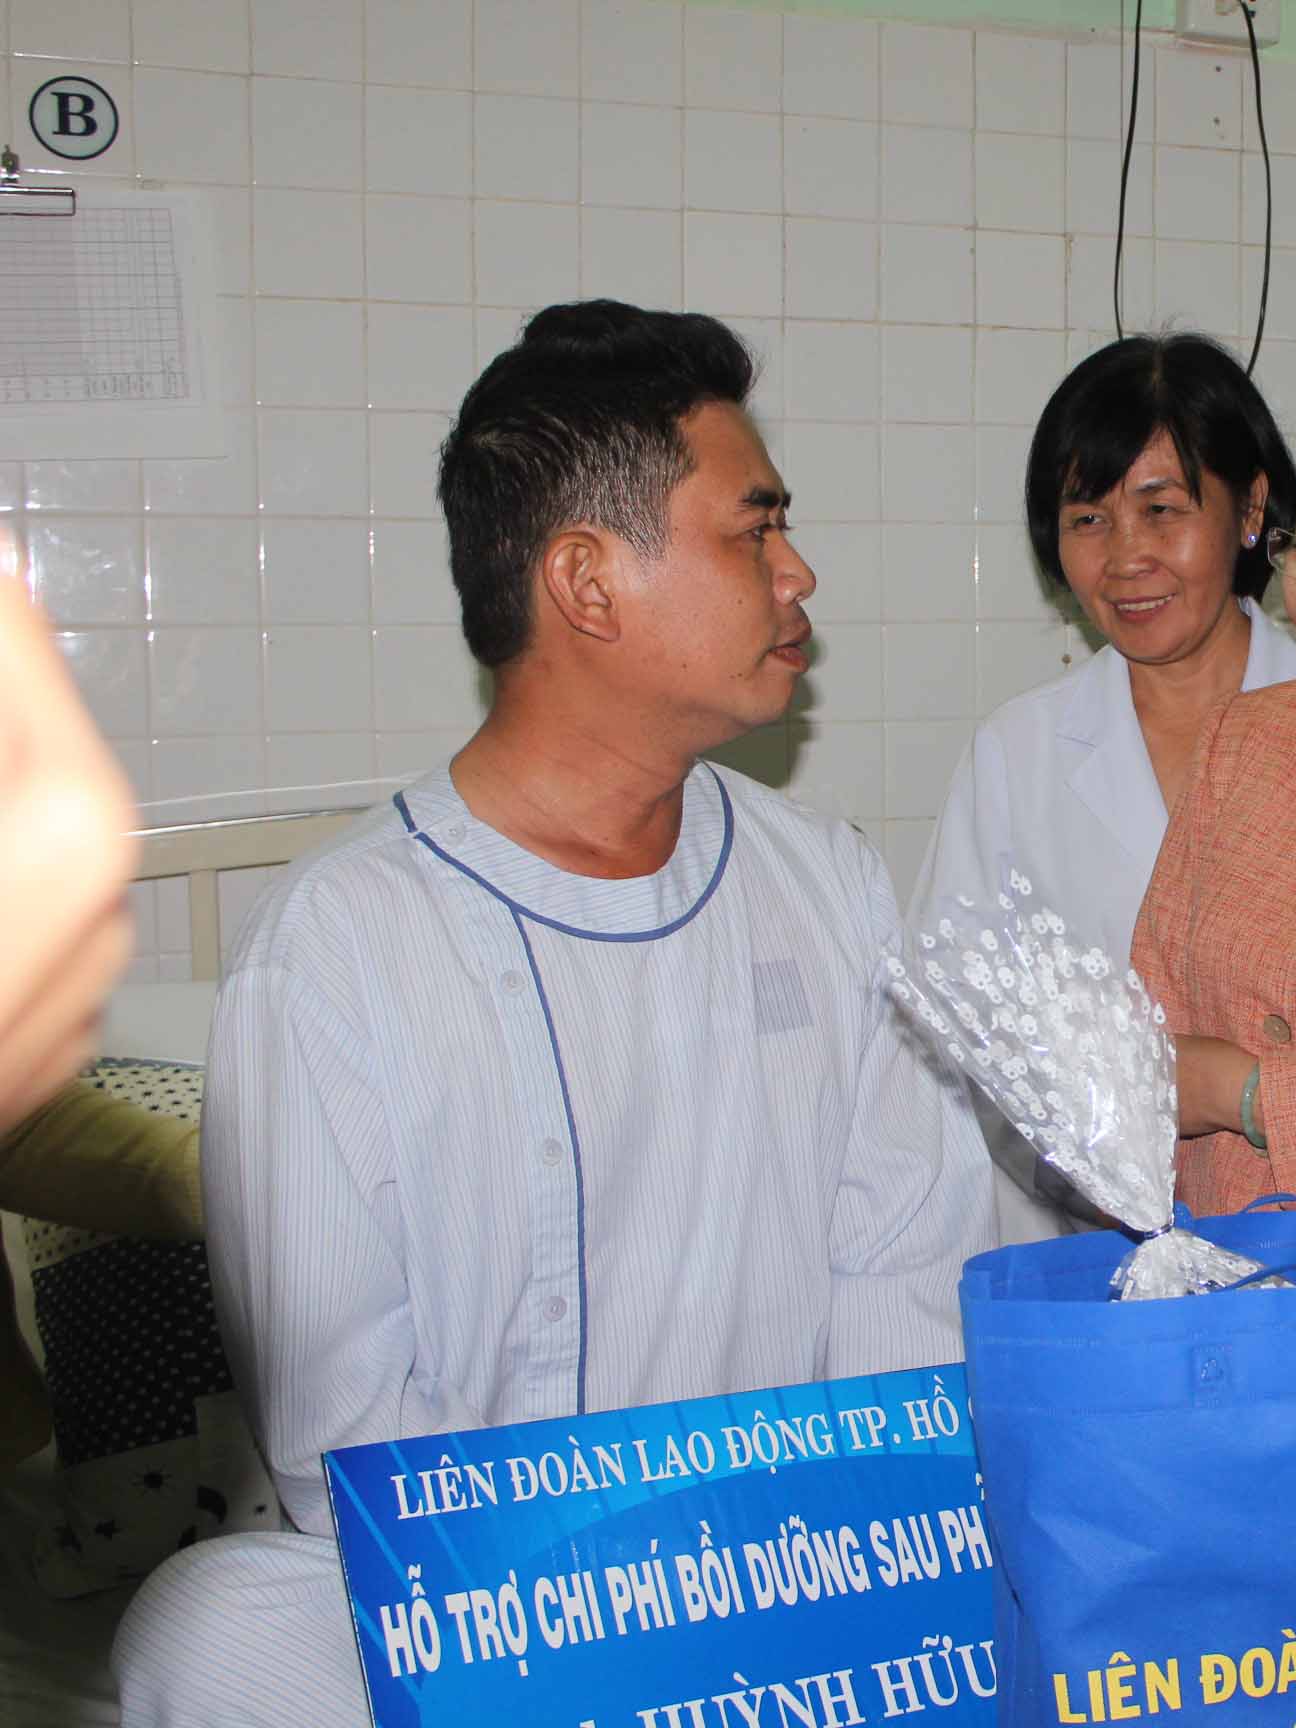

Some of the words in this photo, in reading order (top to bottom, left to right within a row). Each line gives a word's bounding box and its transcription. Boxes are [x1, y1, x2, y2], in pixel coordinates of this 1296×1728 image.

[50, 92, 98, 136] B
[390, 1454, 499, 1520] LIÊN
[506, 1436, 628, 1502] ĐOÀN
[632, 1431, 716, 1482] LAO
[721, 1410, 835, 1475] ĐỘNG
[838, 1405, 901, 1450] TP.
[902, 1374, 960, 1441] HỒ
[380, 1564, 440, 1677] HỖ
[445, 1569, 529, 1677] TRỢ
[534, 1570, 605, 1650] CHI
[606, 1539, 675, 1636] PHÍ
[675, 1519, 749, 1624] BỒI
[742, 1514, 866, 1608] DƯỠNG
[869, 1514, 941, 1589] SAU
[938, 1472, 993, 1574] PH
[871, 1634, 997, 1718] HỮU
[1053, 1651, 1182, 1723] LIÊN
